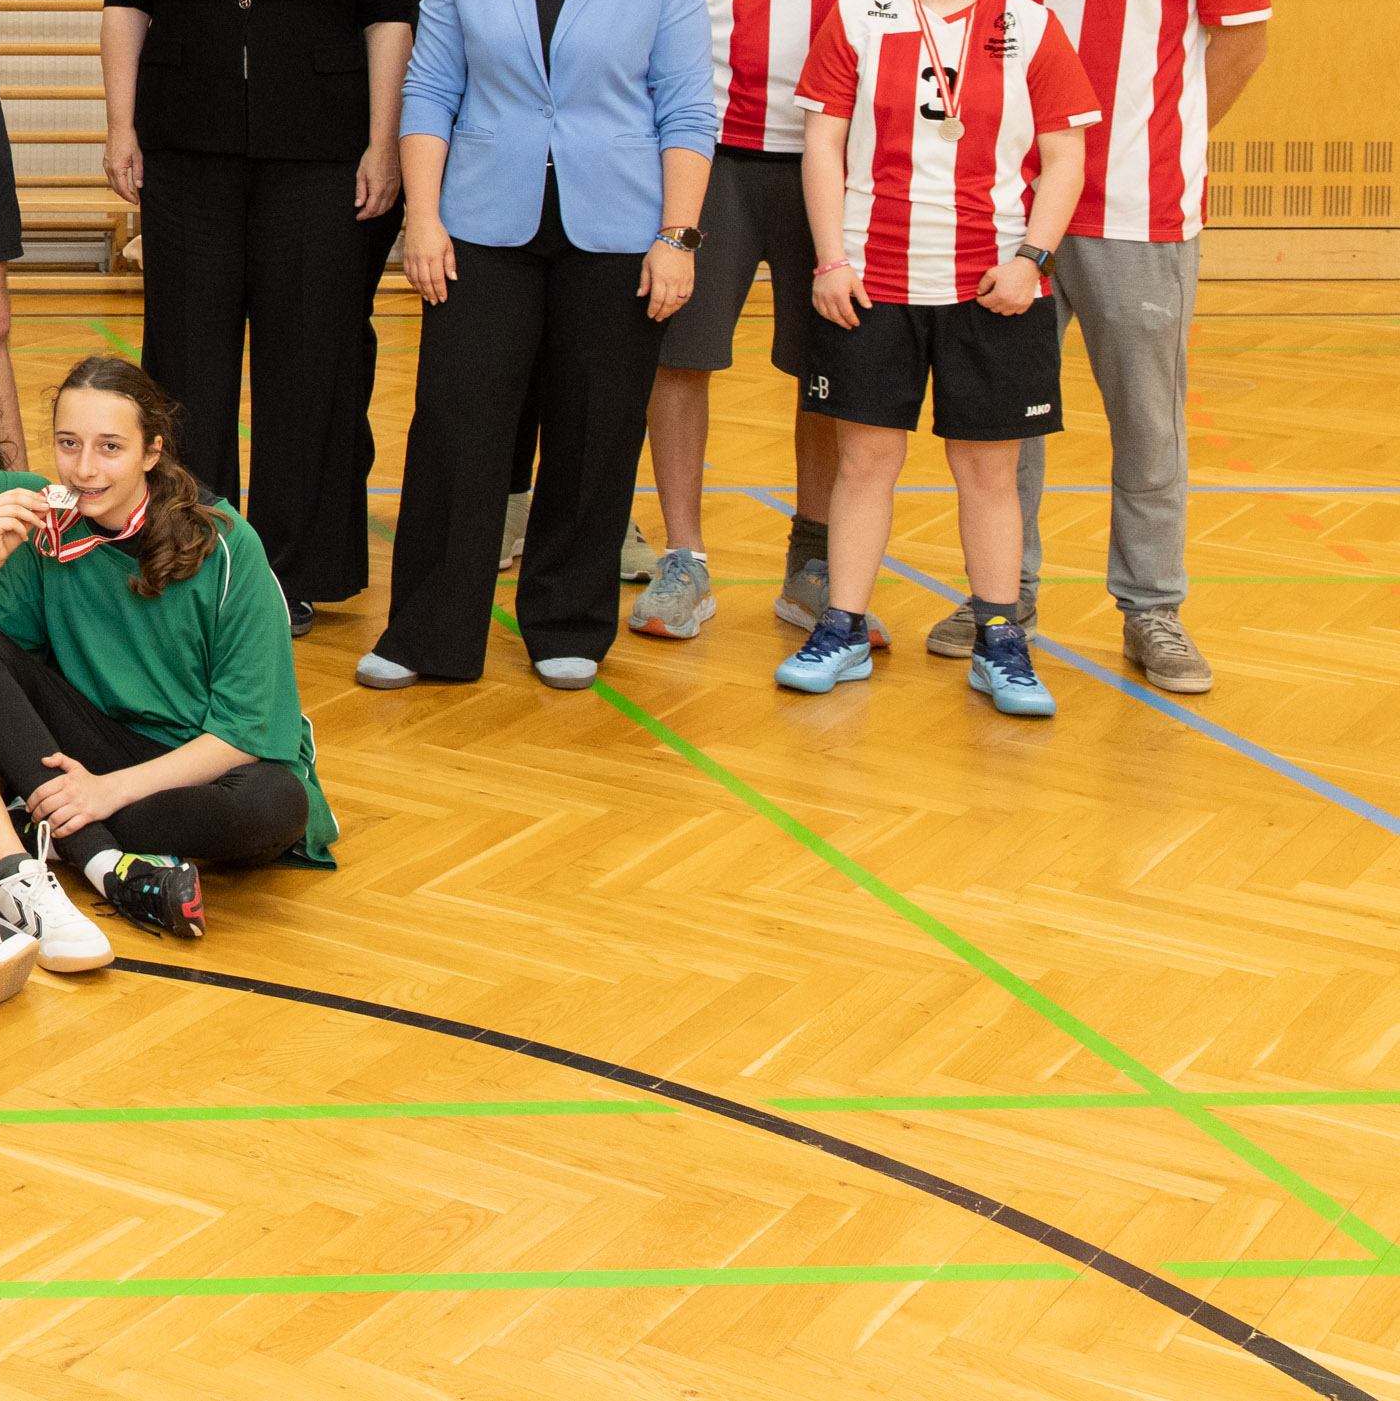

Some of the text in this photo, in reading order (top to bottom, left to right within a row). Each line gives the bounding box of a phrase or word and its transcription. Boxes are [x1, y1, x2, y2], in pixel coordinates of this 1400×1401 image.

[867, 10, 898, 19] erima
[919, 66, 959, 121] 3
[1025, 403, 1051, 417] JAKO
